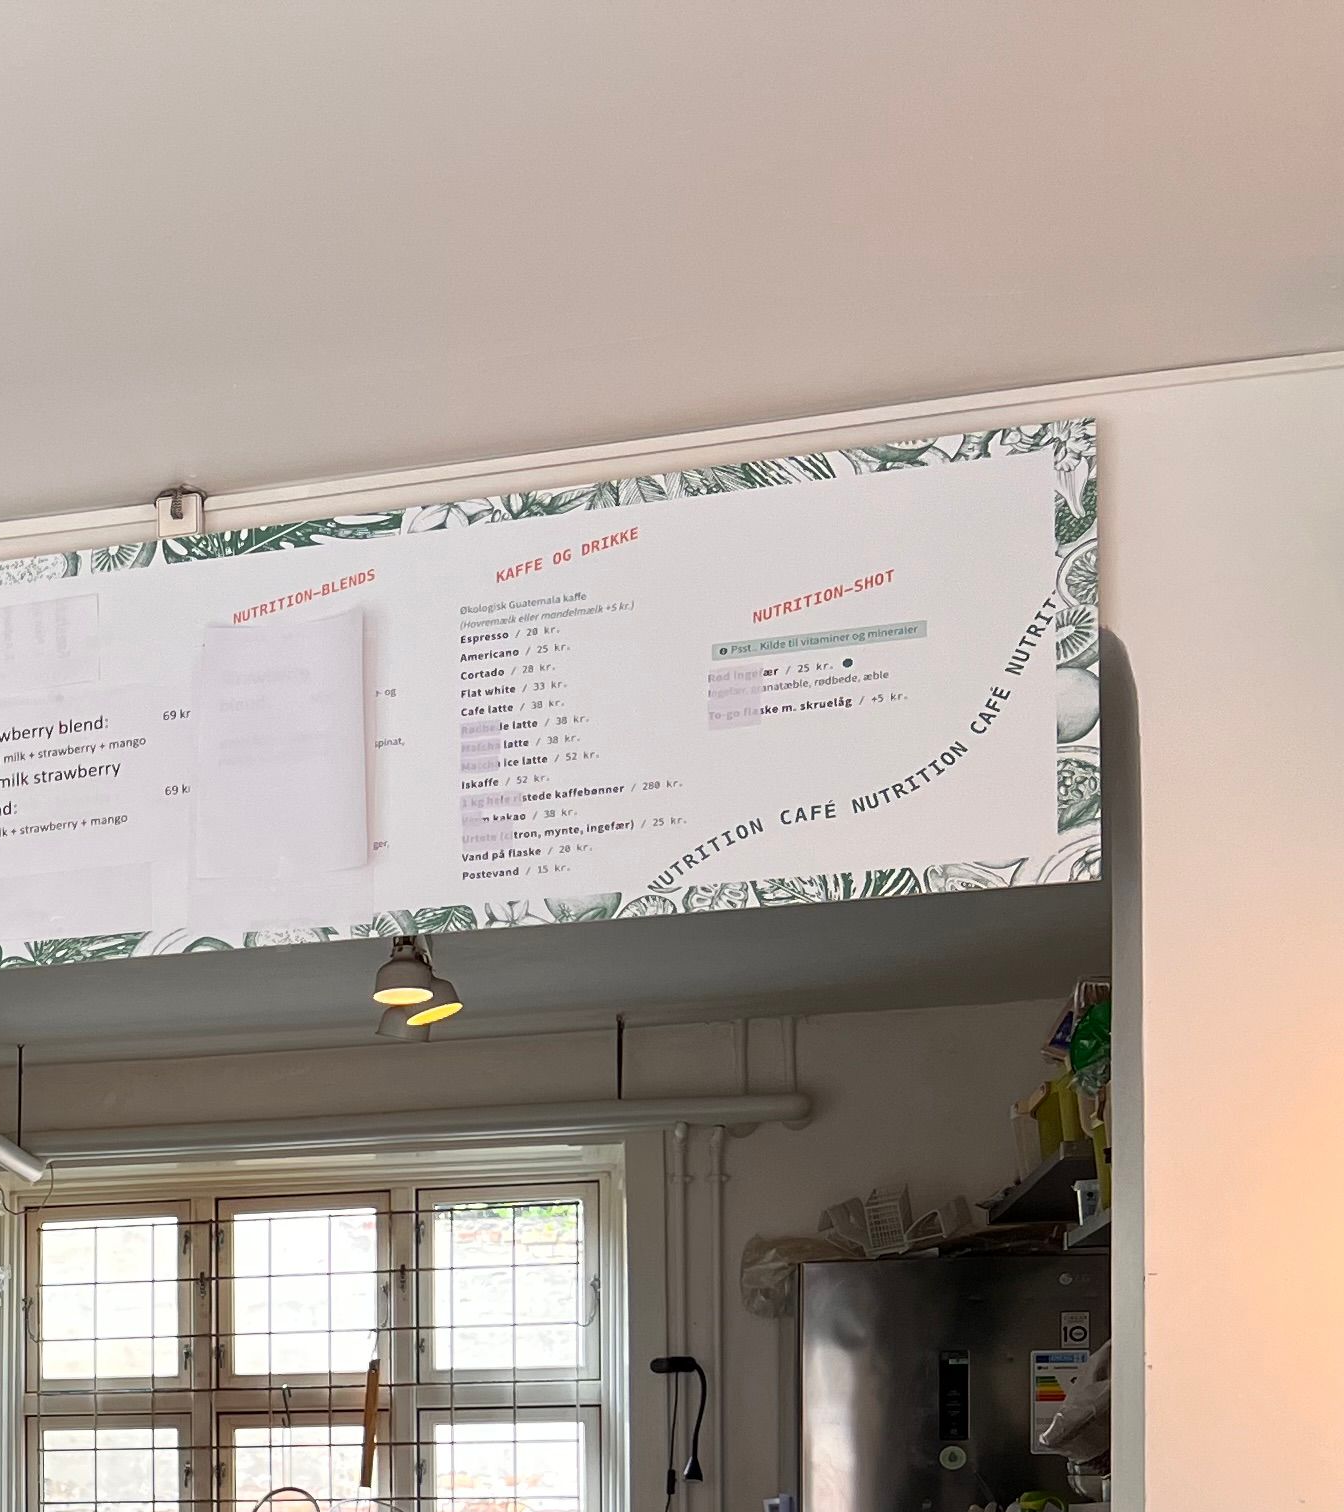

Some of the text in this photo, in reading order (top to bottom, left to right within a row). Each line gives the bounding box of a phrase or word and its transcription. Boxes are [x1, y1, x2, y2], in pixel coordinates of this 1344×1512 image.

[496, 527, 639, 583] KAFFE OG DRIKKE
[233, 569, 375, 625] NUTRITION-BLENDS
[509, 596, 560, 609] Guatemala
[563, 592, 587, 602] kaffe
[753, 569, 895, 624] NUTRITION-SHOT
[518, 613, 539, 622] eller
[461, 632, 509, 645] Espresso
[544, 626, 560, 634] kr.
[760, 640, 786, 650] Kilde
[788, 638, 798, 648] til
[801, 634, 849, 647] vitaminer
[852, 632, 865, 641] og
[868, 625, 918, 638] mineraler
[460, 643, 570, 662] Americano 25 kr.
[461, 668, 504, 680] Cortado
[540, 663, 555, 671] kr.
[797, 664, 810, 673] 25
[816, 662, 833, 671] kr.
[863, 670, 889, 681] æble
[461, 681, 567, 698] Flat white 33 kr.
[461, 707, 484, 716] Cafe
[488, 704, 513, 714] latte
[782, 704, 797, 713] m.
[800, 698, 852, 711] skruelåg
[890, 692, 907, 701] kr.
[163, 709, 190, 720] 69 kr
[58, 715, 109, 735] blend:
[513, 720, 538, 729] latte
[4, 752, 25, 764] milk
[38, 743, 96, 759] strawberry
[109, 737, 146, 750] mango
[504, 739, 529, 749] latte
[504, 758, 519, 766] ice
[522, 756, 548, 765] latte
[566, 753, 577, 761] 52
[34, 762, 121, 784] strawberry
[165, 786, 178, 796] 69
[462, 778, 499, 789] Iskaffe
[517, 776, 527, 784] 52
[555, 784, 624, 799] kaffebønner
[666, 780, 683, 789] kr.
[648, 818, 764, 892] NUTRITION
[780, 800, 837, 826] CAFÉ
[852, 741, 968, 814] NUTRITION
[970, 686, 1011, 735] CAFÉ
[562, 808, 577, 816] kr.
[19, 819, 77, 835] strawberry
[91, 814, 128, 827] mango
[545, 826, 583, 837] mynte,
[586, 819, 634, 834] ingefær)
[653, 818, 664, 827] 25
[671, 816, 687, 825] kr.
[462, 851, 488, 862] Vand
[492, 850, 505, 860] på
[508, 848, 541, 858] flaske
[463, 867, 519, 880] Postevand
[538, 865, 548, 873] 15
